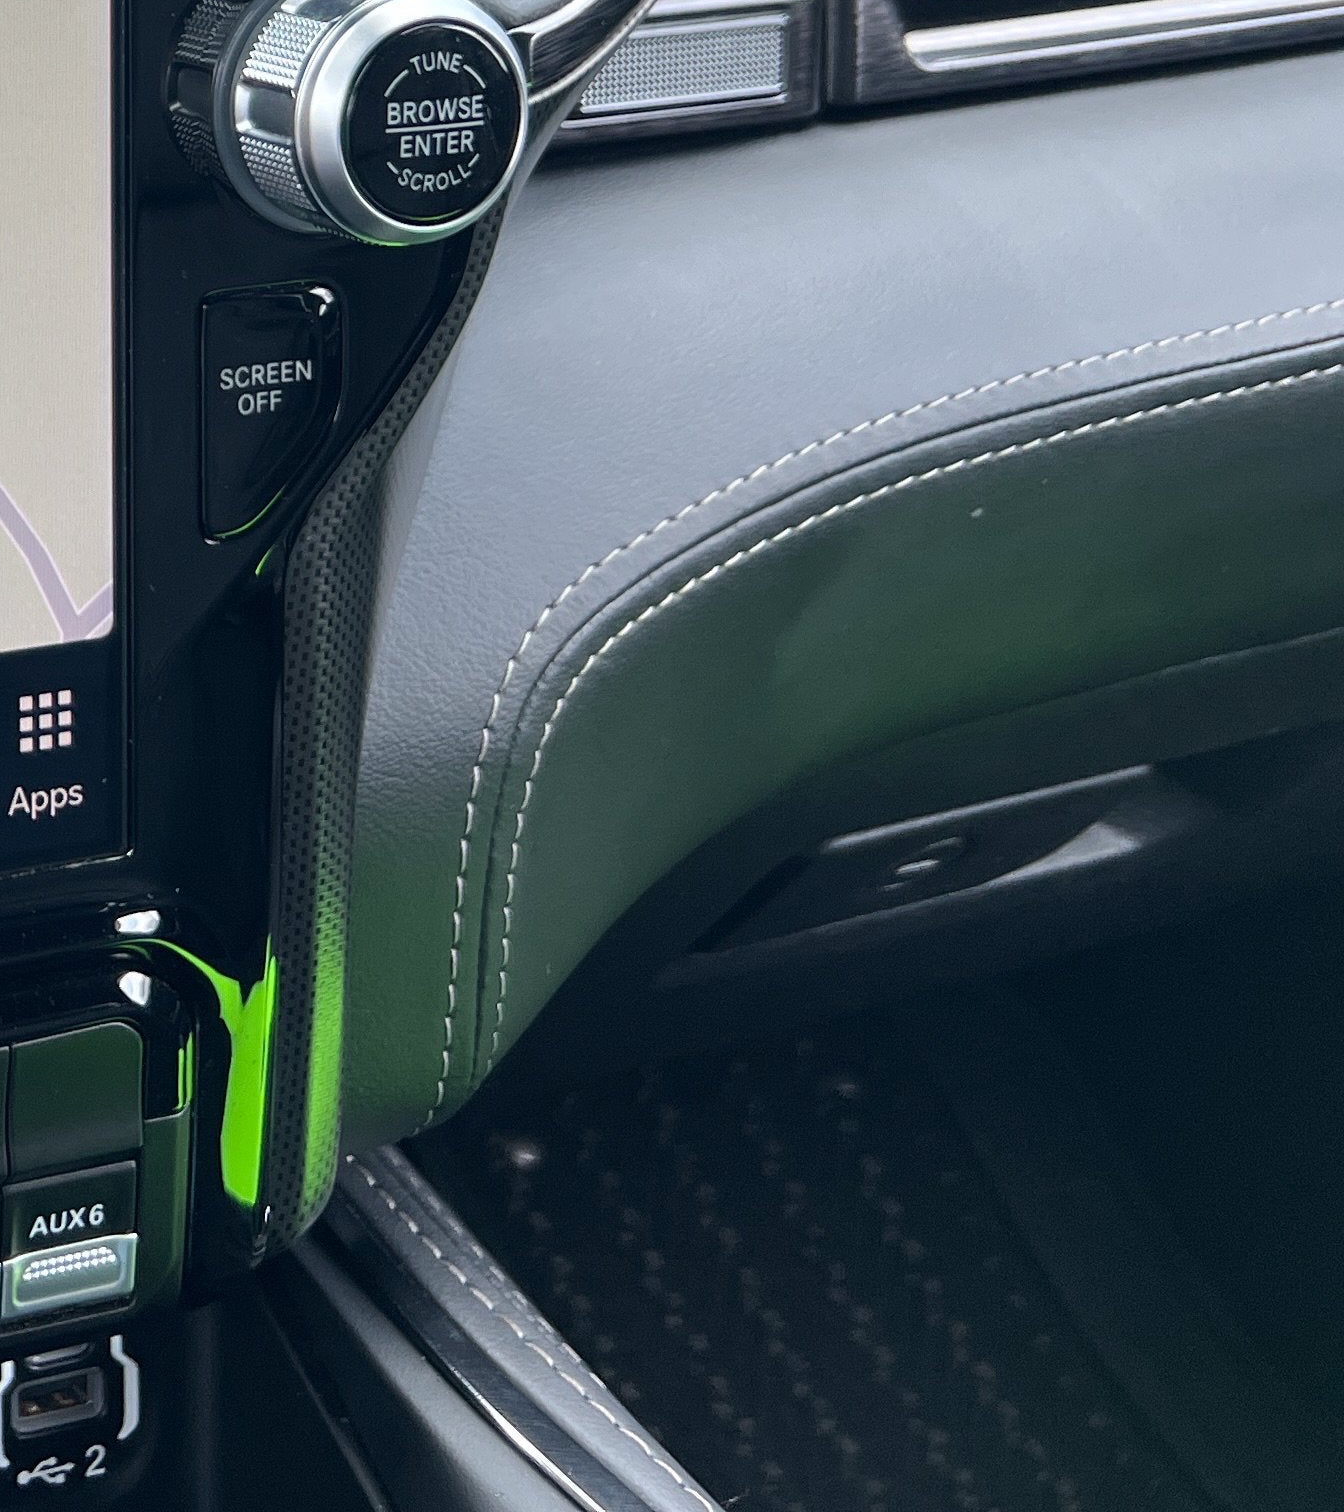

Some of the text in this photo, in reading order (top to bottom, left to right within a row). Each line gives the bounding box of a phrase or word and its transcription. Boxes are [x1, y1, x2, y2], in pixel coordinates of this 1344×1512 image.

[409, 50, 464, 75] TUNE
[386, 94, 484, 125] BROWSE
[399, 130, 474, 158] ENTER
[397, 164, 473, 193] SCROLL
[219, 360, 313, 389] SCREEN
[237, 391, 282, 416] OFF
[8, 782, 85, 821] Apps
[28, 1203, 105, 1239] AUX 6
[85, 1444, 107, 1478] 2
